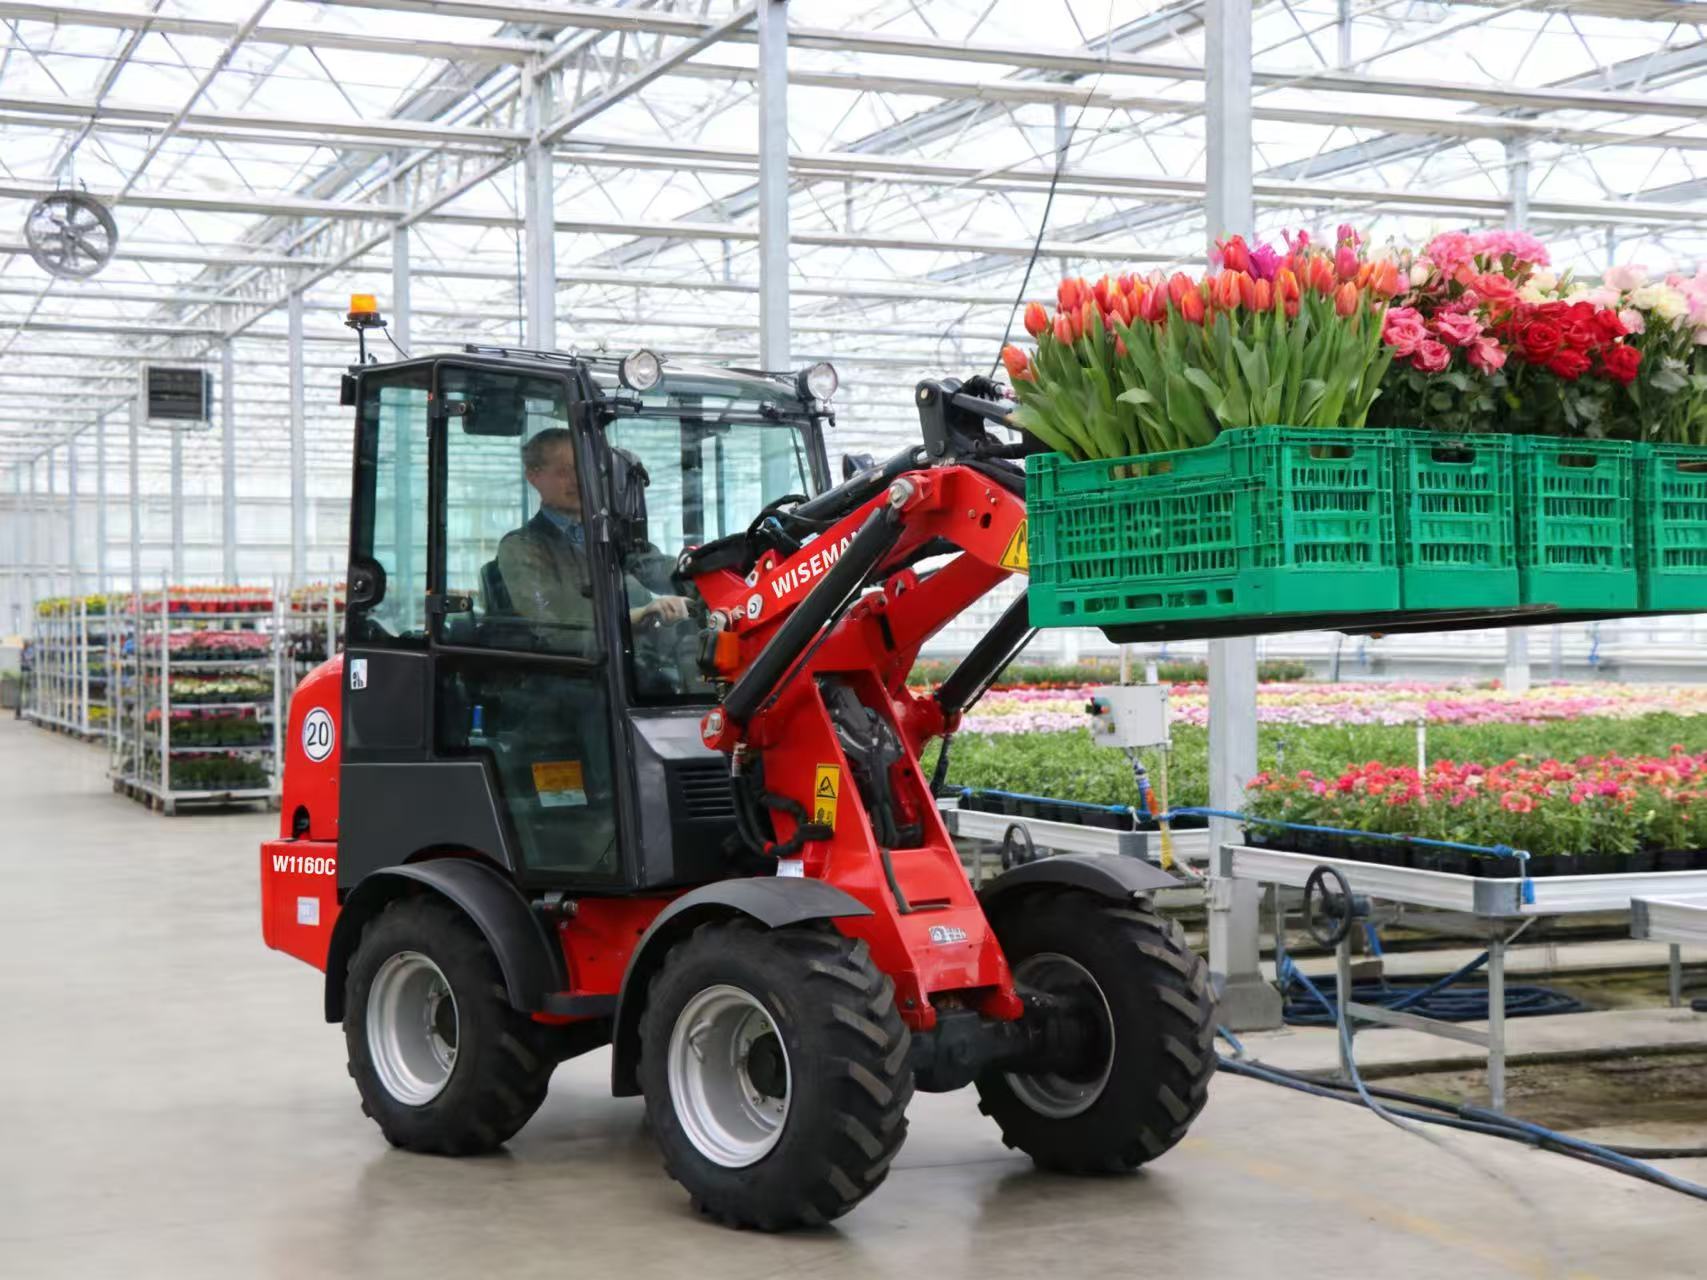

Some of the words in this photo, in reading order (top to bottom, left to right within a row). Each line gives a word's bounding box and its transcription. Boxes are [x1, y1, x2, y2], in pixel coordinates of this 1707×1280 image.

[771, 528, 861, 599] WISEMA
[307, 722, 329, 747] 20
[272, 855, 336, 876] W1160C
